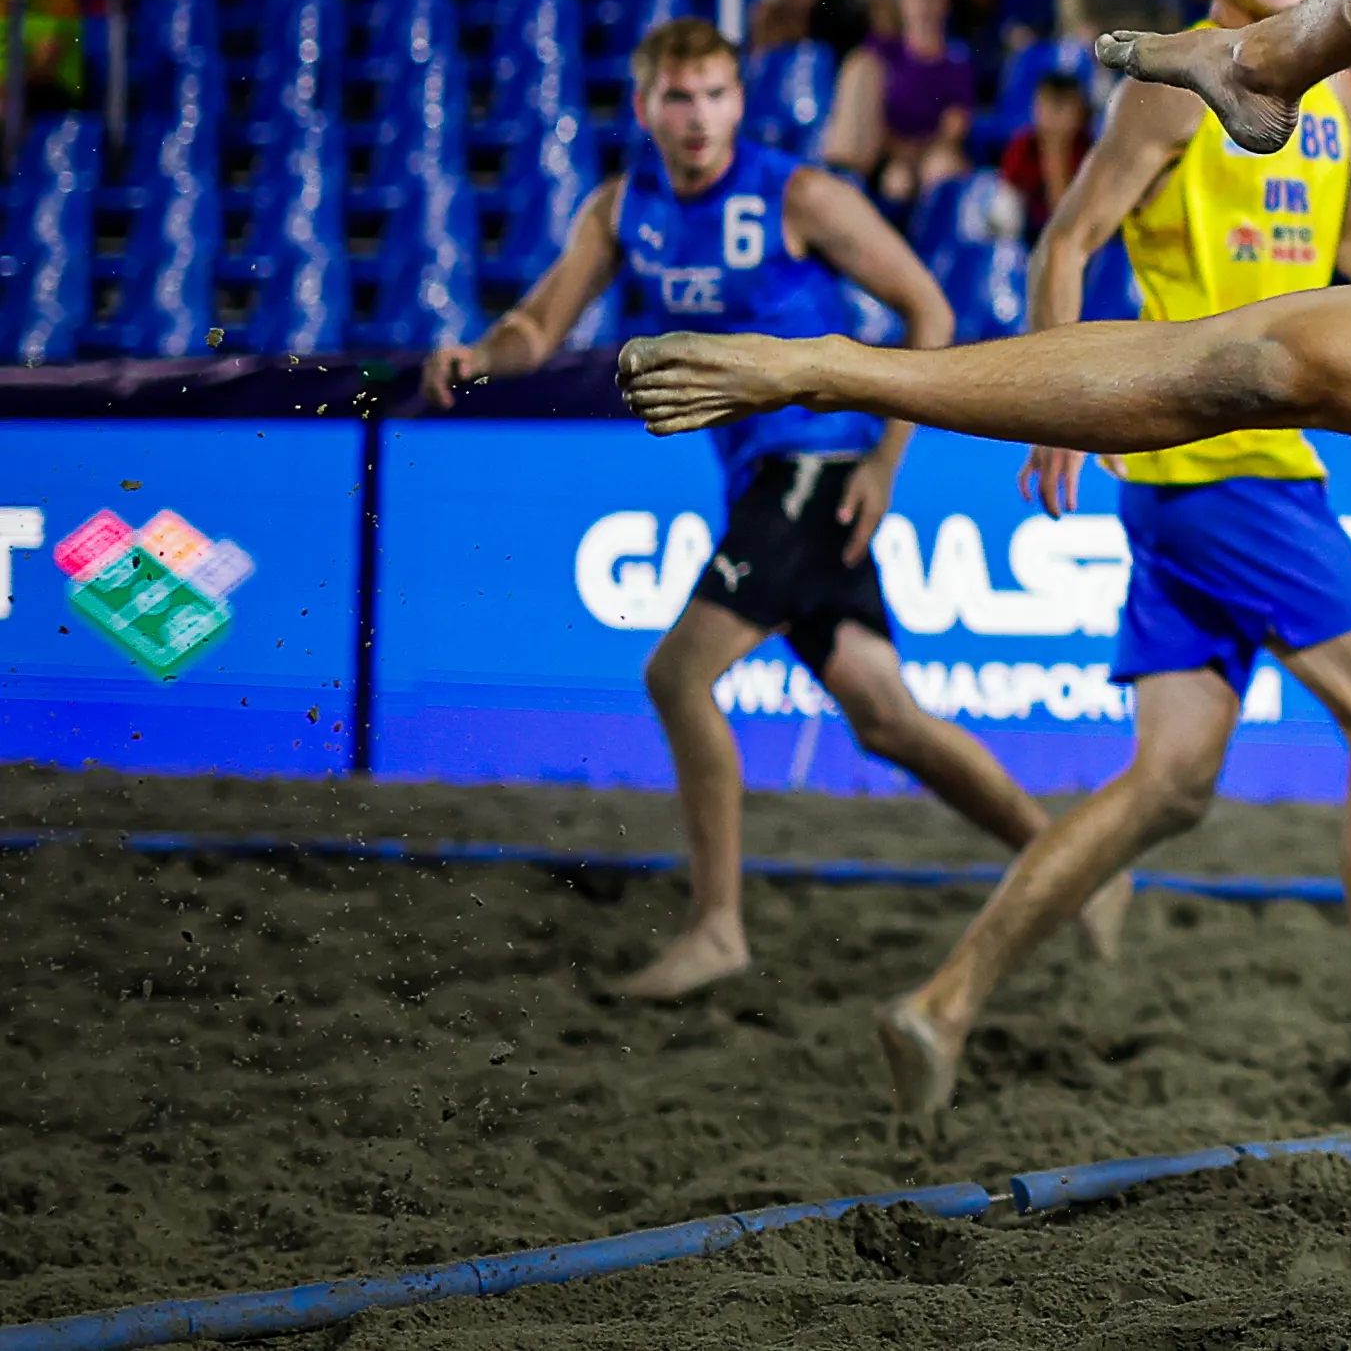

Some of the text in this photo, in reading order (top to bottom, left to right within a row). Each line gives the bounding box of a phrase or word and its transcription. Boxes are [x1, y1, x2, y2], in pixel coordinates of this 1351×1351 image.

[1300, 113, 1342, 162] 88
[722, 194, 766, 270] 6
[661, 266, 725, 314] CZE
